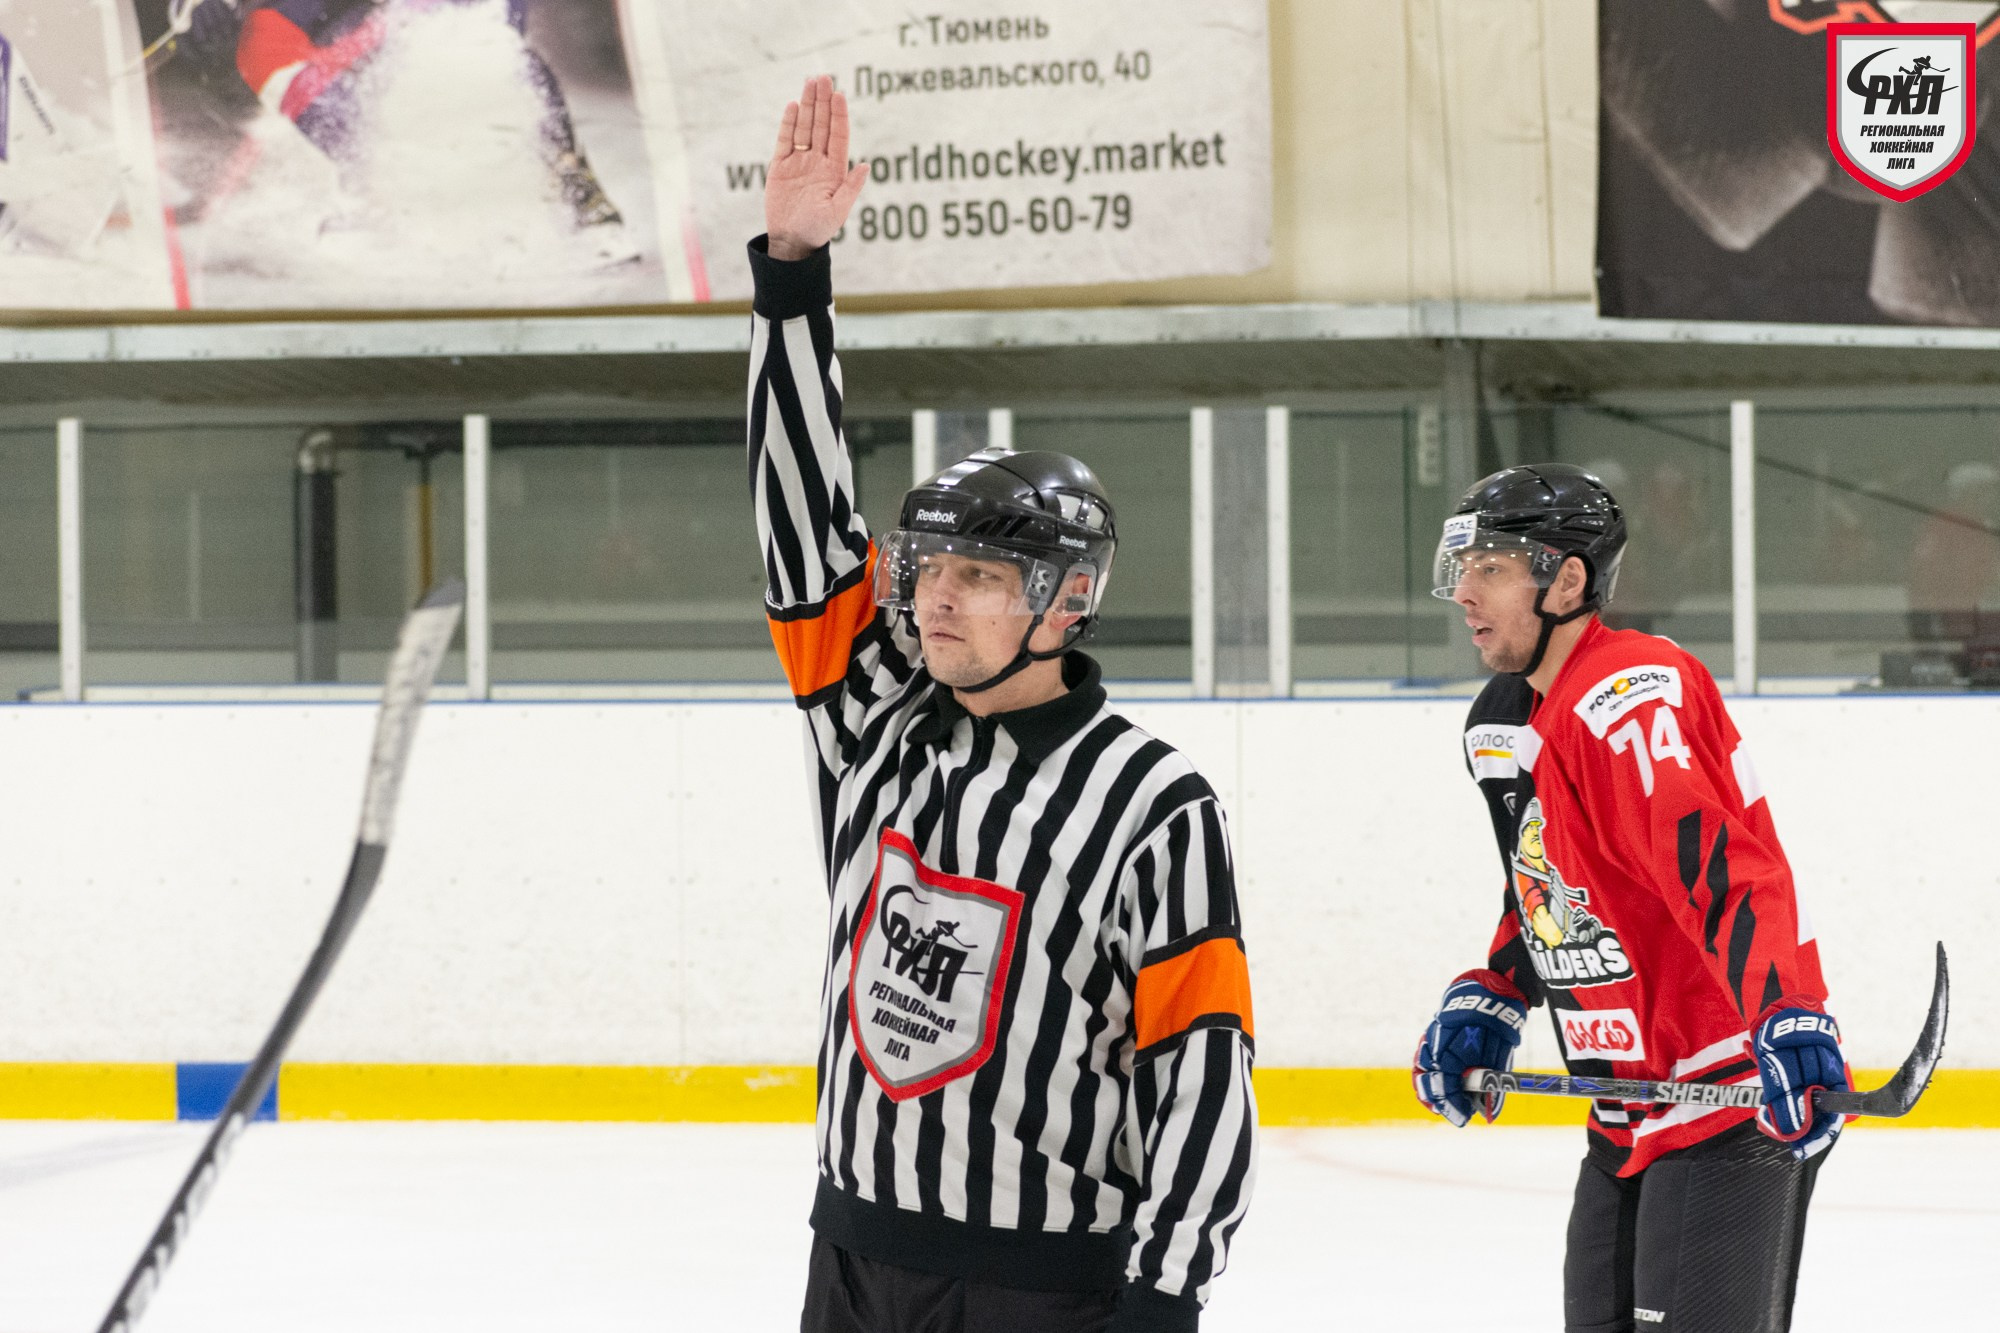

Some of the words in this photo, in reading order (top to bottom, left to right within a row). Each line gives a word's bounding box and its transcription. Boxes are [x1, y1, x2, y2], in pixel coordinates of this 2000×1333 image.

[929, 15, 1050, 43] Тюмень
[855, 59, 1106, 99] Пржевальского,
[1114, 51, 1151, 81] 40
[726, 131, 1227, 191] wworldhockey.market
[859, 204, 928, 241] 800
[942, 195, 1131, 236] 550-60-79
[916, 508, 957, 524] Reebok
[1059, 535, 1087, 550] Reebok
[1471, 734, 1514, 749] ОЛОС
[1607, 705, 1692, 798] 74
[868, 980, 956, 1033] РЕГИОНАЛЬНАЯ
[871, 1007, 940, 1045] ХОККЕЙНАЯ
[1772, 1016, 1838, 1040] BAU
[883, 1038, 911, 1061] ЛИГА
[1655, 1081, 1764, 1108] SHERWO
